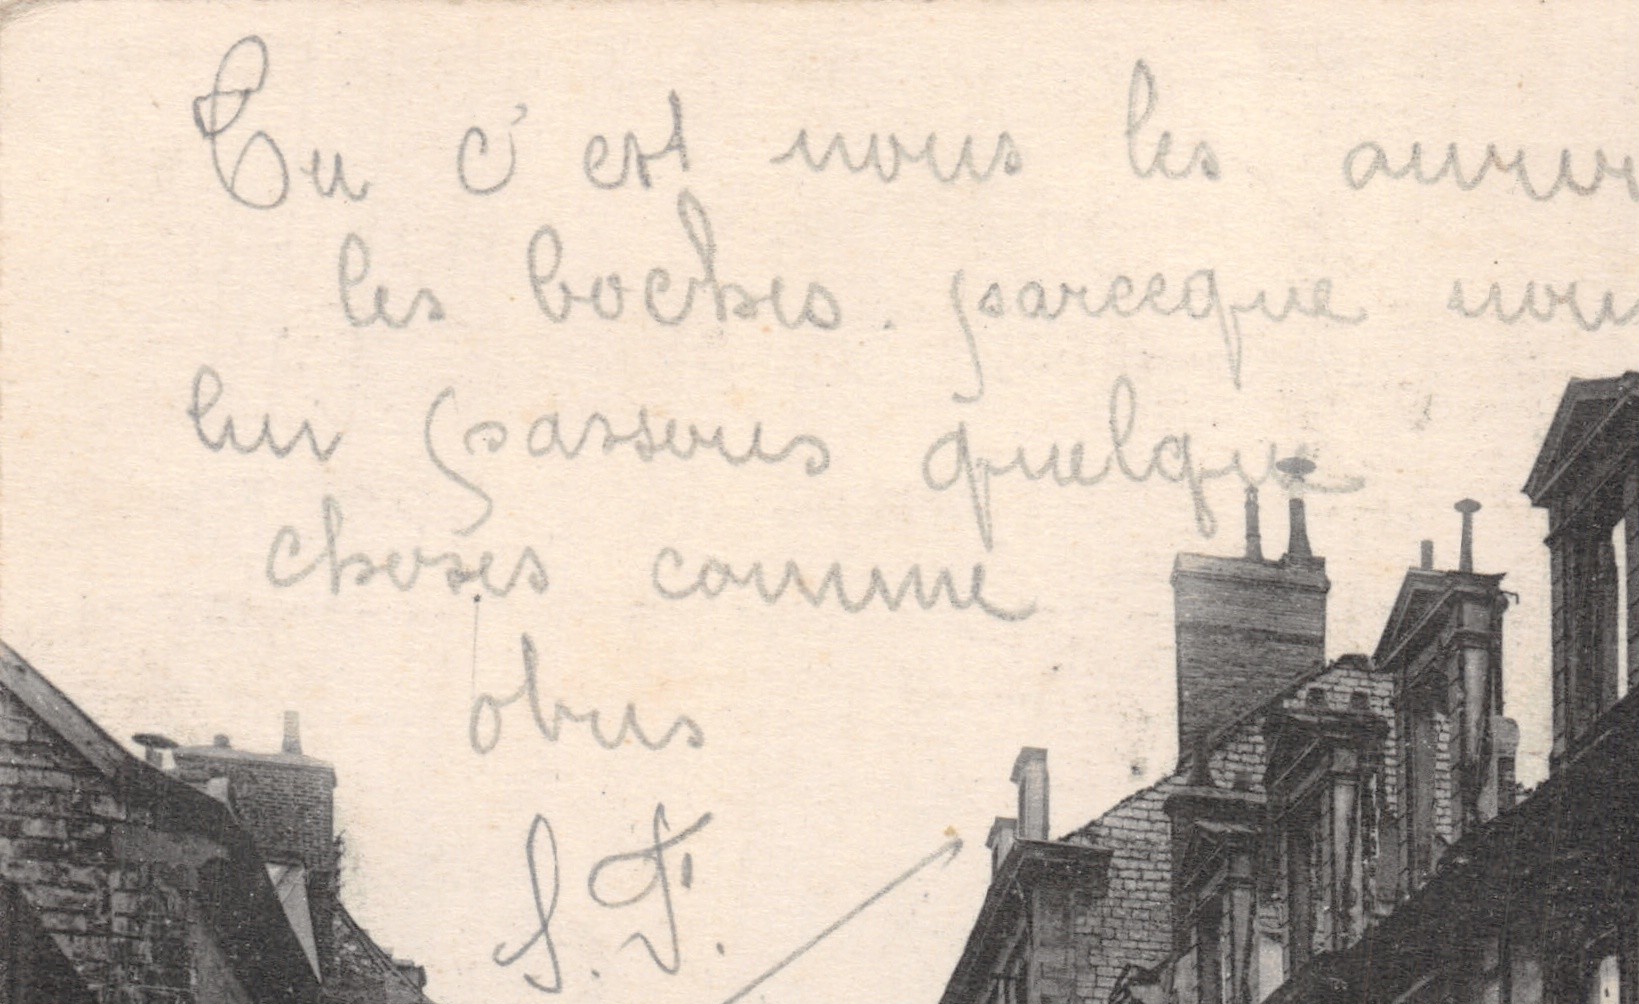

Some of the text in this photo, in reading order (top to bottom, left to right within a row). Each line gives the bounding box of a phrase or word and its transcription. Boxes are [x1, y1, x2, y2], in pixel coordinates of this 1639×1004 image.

[770, 129, 1021, 185] nous
[1125, 59, 1218, 179] les
[339, 233, 445, 328] les
[267, 495, 1038, 622] choses comme
[470, 633, 704, 754] obus
